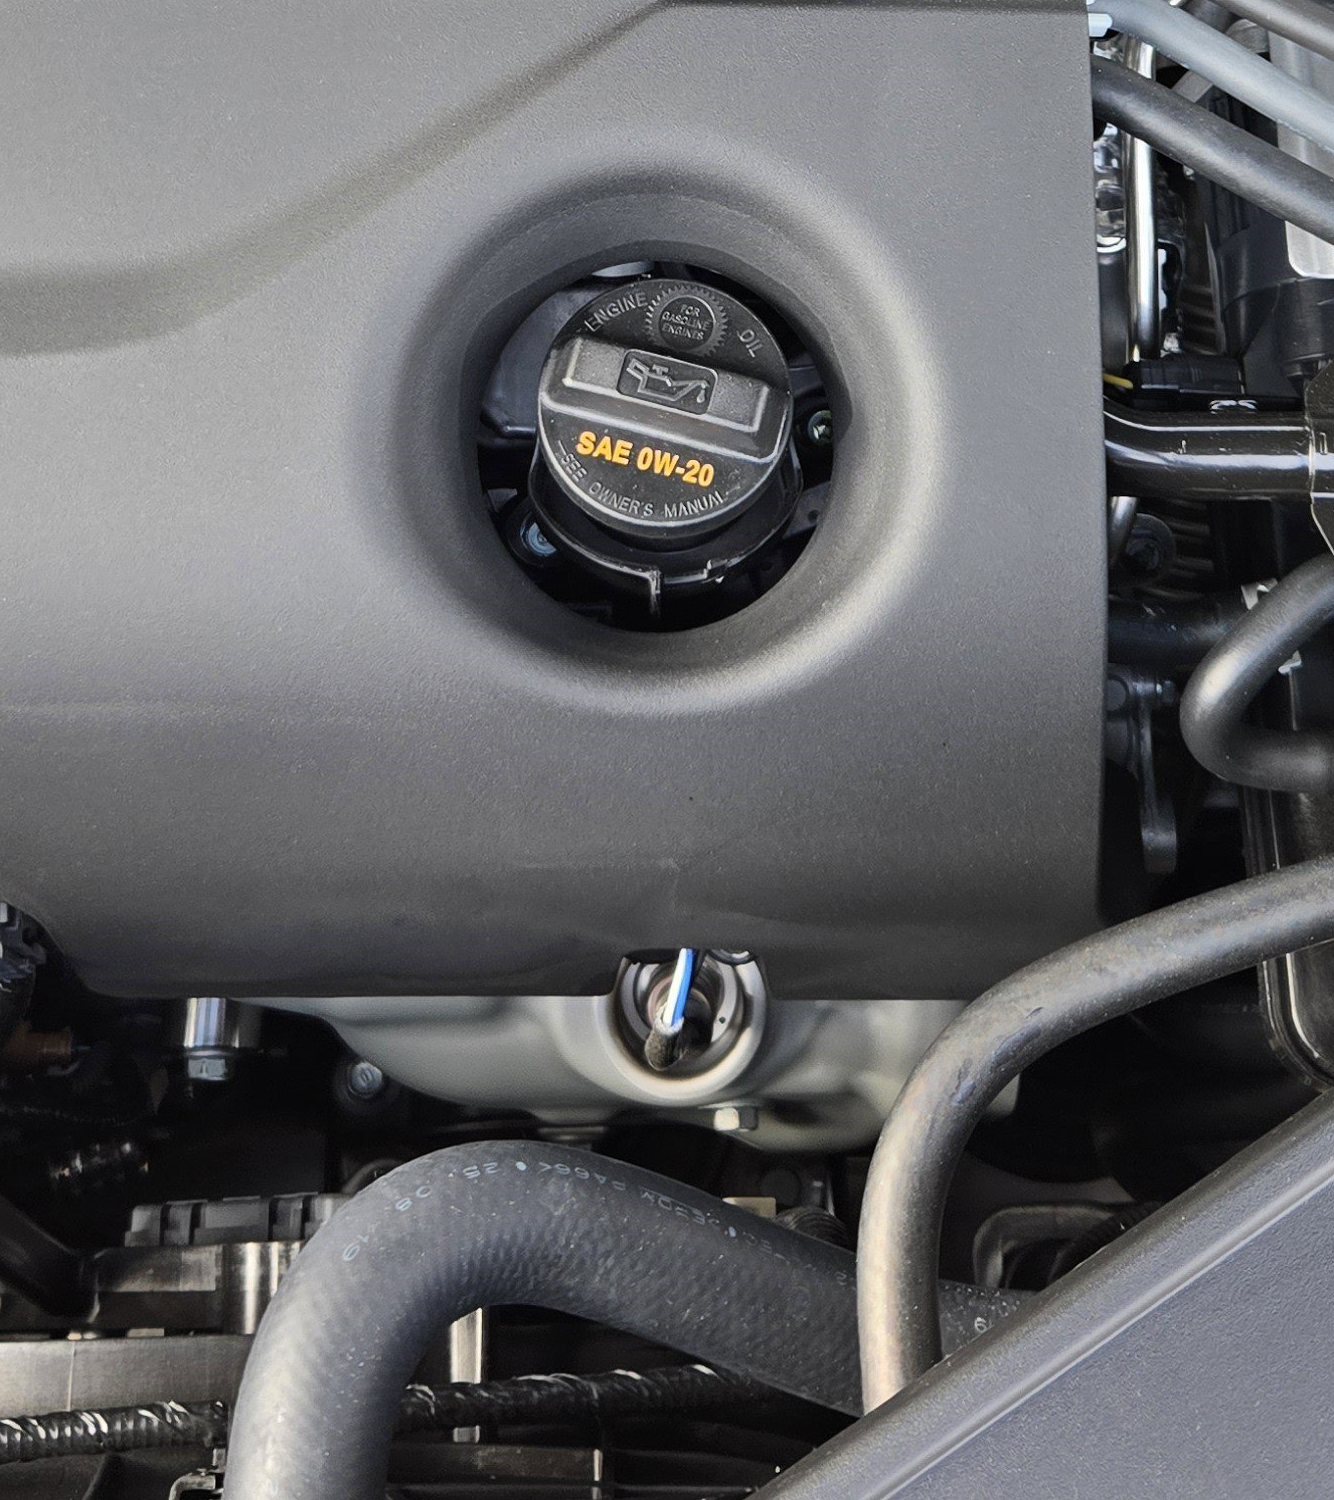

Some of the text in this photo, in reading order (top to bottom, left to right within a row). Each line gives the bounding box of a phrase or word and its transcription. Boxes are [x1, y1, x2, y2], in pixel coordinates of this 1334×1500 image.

[661, 310, 710, 332] GASOLINE
[679, 303, 702, 317] FOR
[584, 291, 765, 359] ENGINE OIL
[662, 323, 705, 341] ENGINES
[575, 430, 716, 489] SAE 0W-20
[588, 482, 655, 517] OWNER'S
